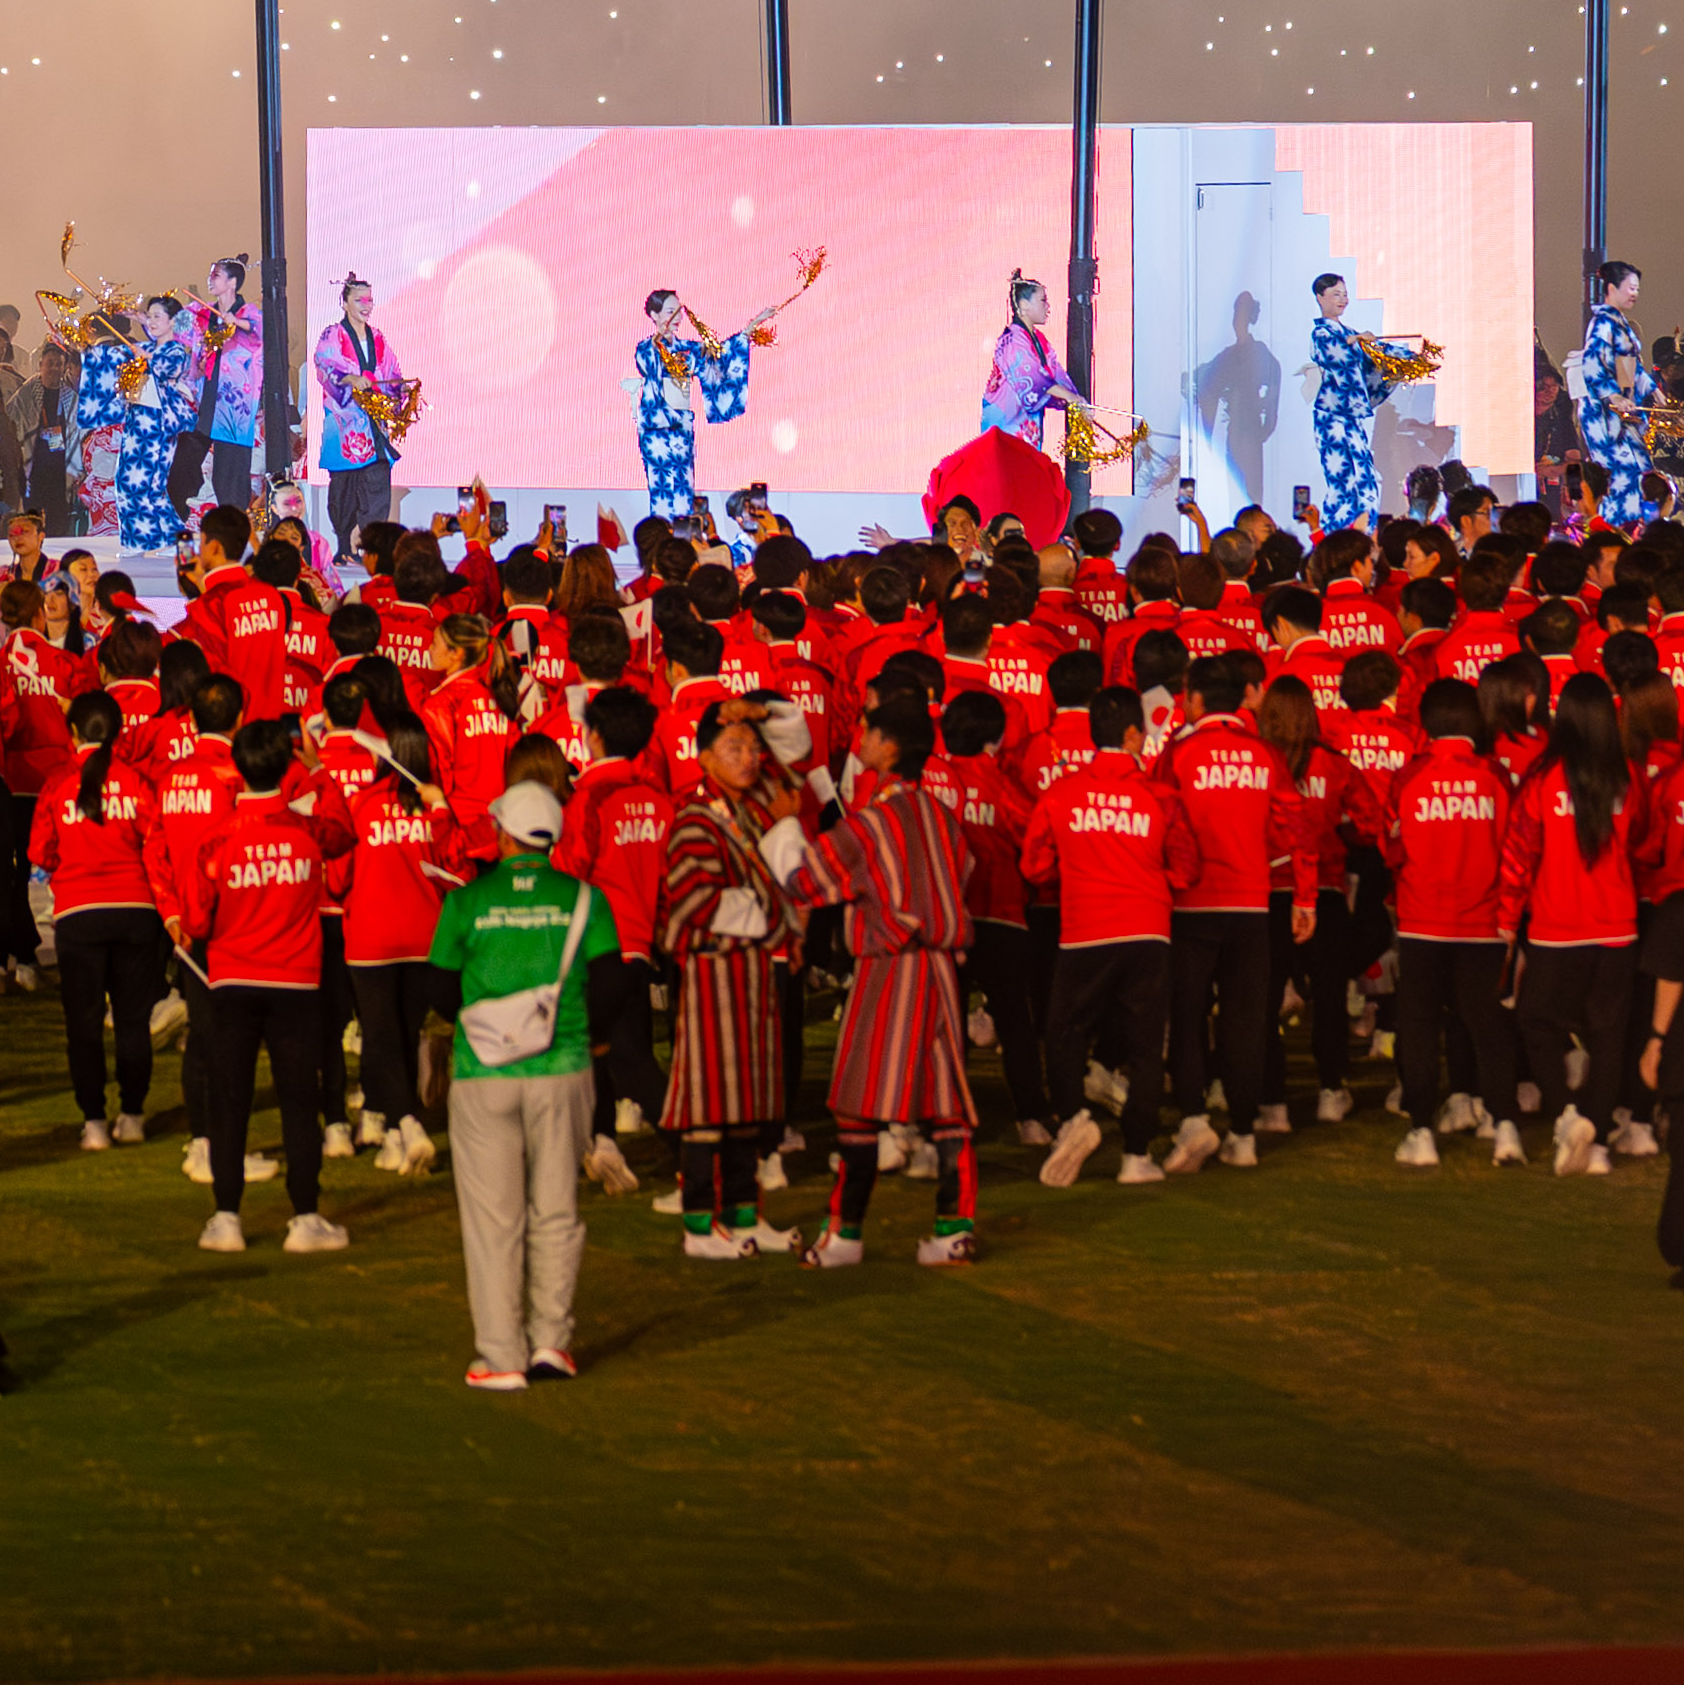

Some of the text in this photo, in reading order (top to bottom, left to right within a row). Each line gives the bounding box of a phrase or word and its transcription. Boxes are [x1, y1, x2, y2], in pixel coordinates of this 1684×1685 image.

[1081, 590, 1115, 601] TEAM
[239, 598, 268, 613] TEAM
[1082, 603, 1129, 623] PAN
[1330, 612, 1367, 624] TEAM
[388, 633, 422, 646] TEAM
[1188, 638, 1226, 648] TEAM
[1465, 643, 1502, 656] TEAM
[722, 659, 741, 671] AM
[989, 658, 1028, 670] TEAM
[1454, 657, 1501, 681] JAP
[18, 676, 55, 696] PAN
[718, 672, 760, 693] PAN
[792, 680, 810, 691] AM
[989, 672, 1043, 695] APAN
[473, 698, 496, 711] TEM
[1313, 688, 1348, 710] APA
[1352, 734, 1389, 747] TEAM
[1062, 750, 1094, 764] EAM
[1210, 750, 1253, 763] TEAM
[1341, 749, 1405, 771] APAN
[1194, 765, 1269, 790] JAPAN
[1432, 780, 1476, 794] TEAM
[1087, 792, 1132, 809] TEAM
[62, 796, 138, 826] JAN
[382, 803, 422, 817] TE
[1415, 796, 1494, 822] JAPAN
[1069, 807, 1150, 838] JAPAN
[245, 843, 292, 860] TEAM
[228, 858, 310, 888] JAPAN
